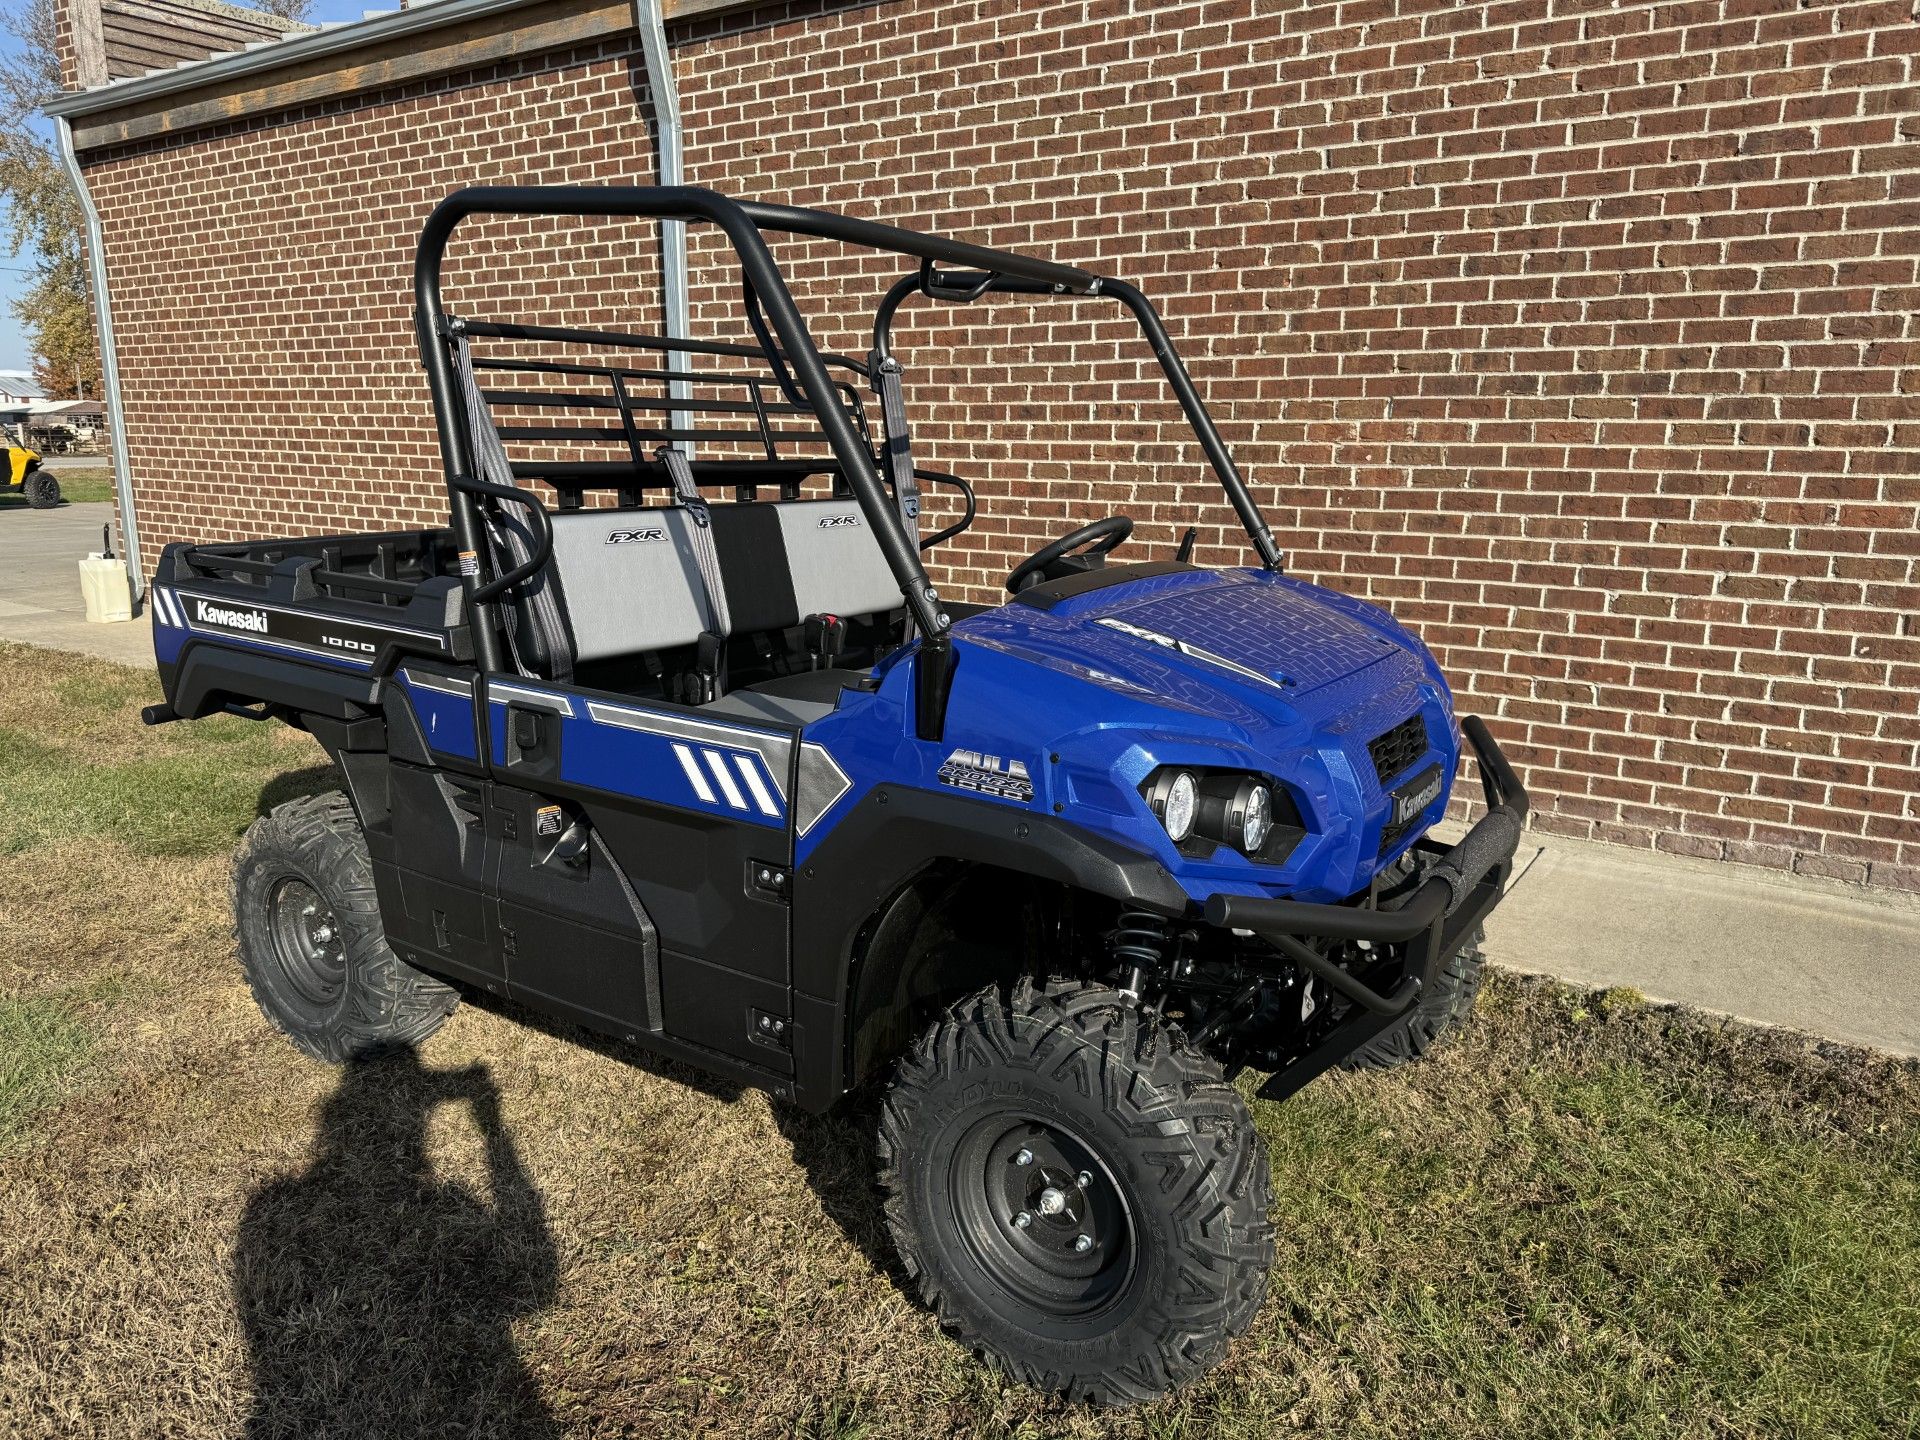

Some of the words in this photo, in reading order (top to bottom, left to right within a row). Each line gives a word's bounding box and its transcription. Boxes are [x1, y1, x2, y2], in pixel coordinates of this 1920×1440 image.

[818, 514, 860, 528] FXR
[605, 528, 668, 545] FXR
[197, 600, 268, 633] Kawasaki
[321, 635, 375, 652] 1000
[1399, 769, 1442, 824] Kawasaki
